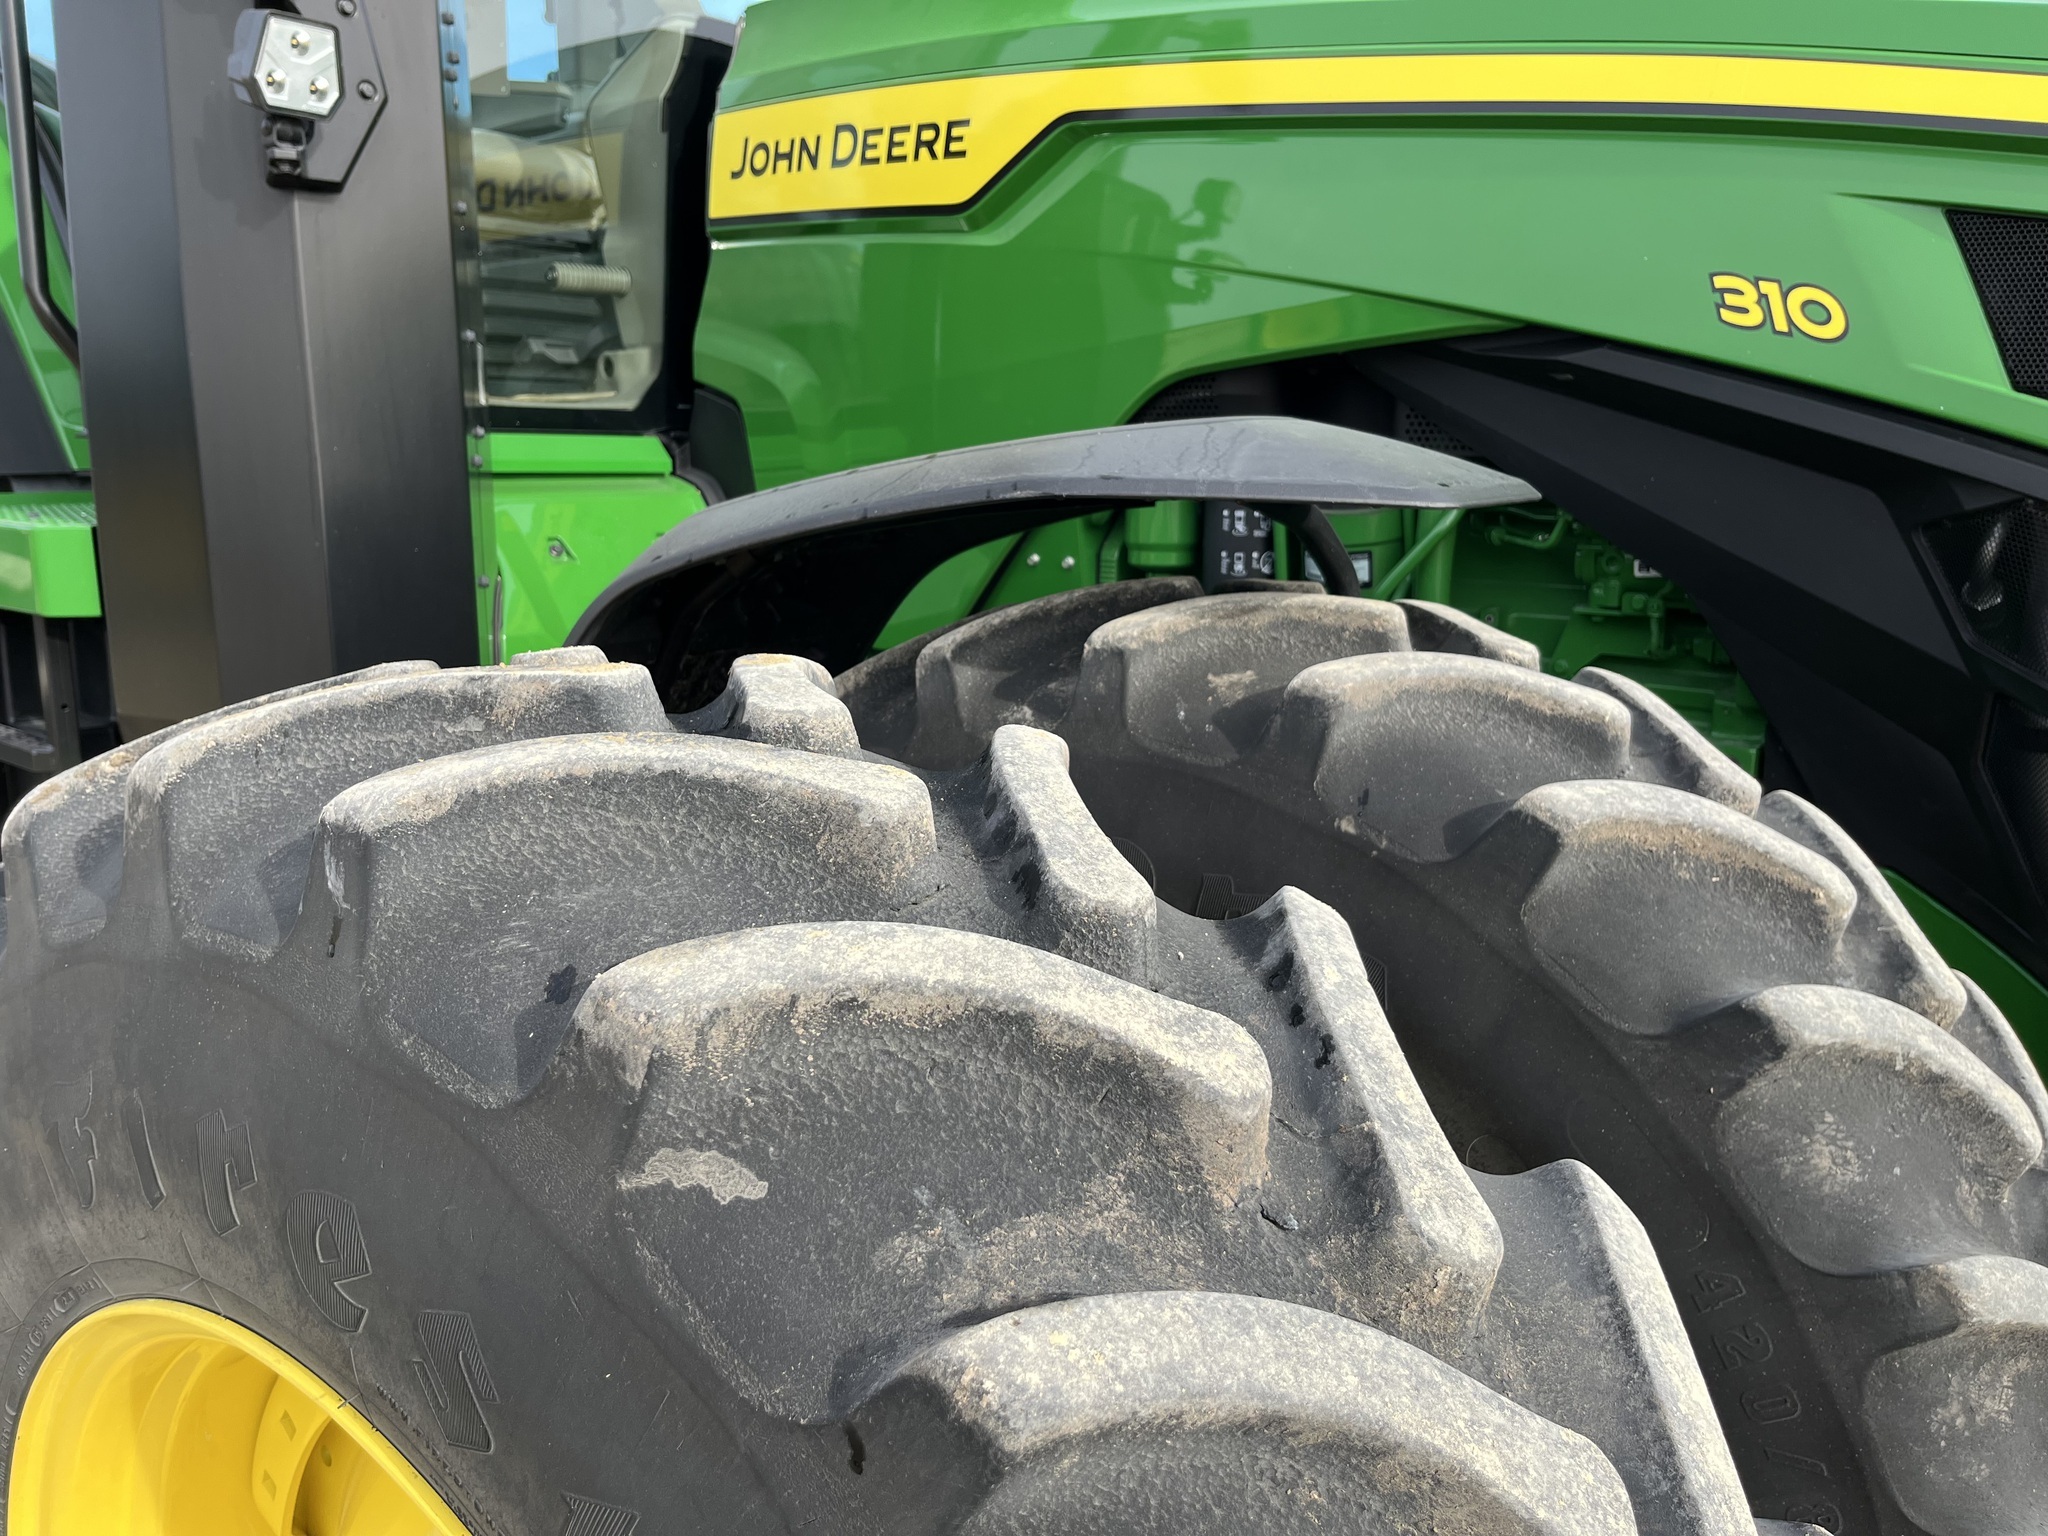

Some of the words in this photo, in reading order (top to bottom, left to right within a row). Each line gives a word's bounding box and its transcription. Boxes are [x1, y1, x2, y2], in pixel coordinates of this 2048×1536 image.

[730, 134, 821, 180] JOHN
[830, 118, 971, 169] DEERE
[1709, 271, 1849, 343] 310
